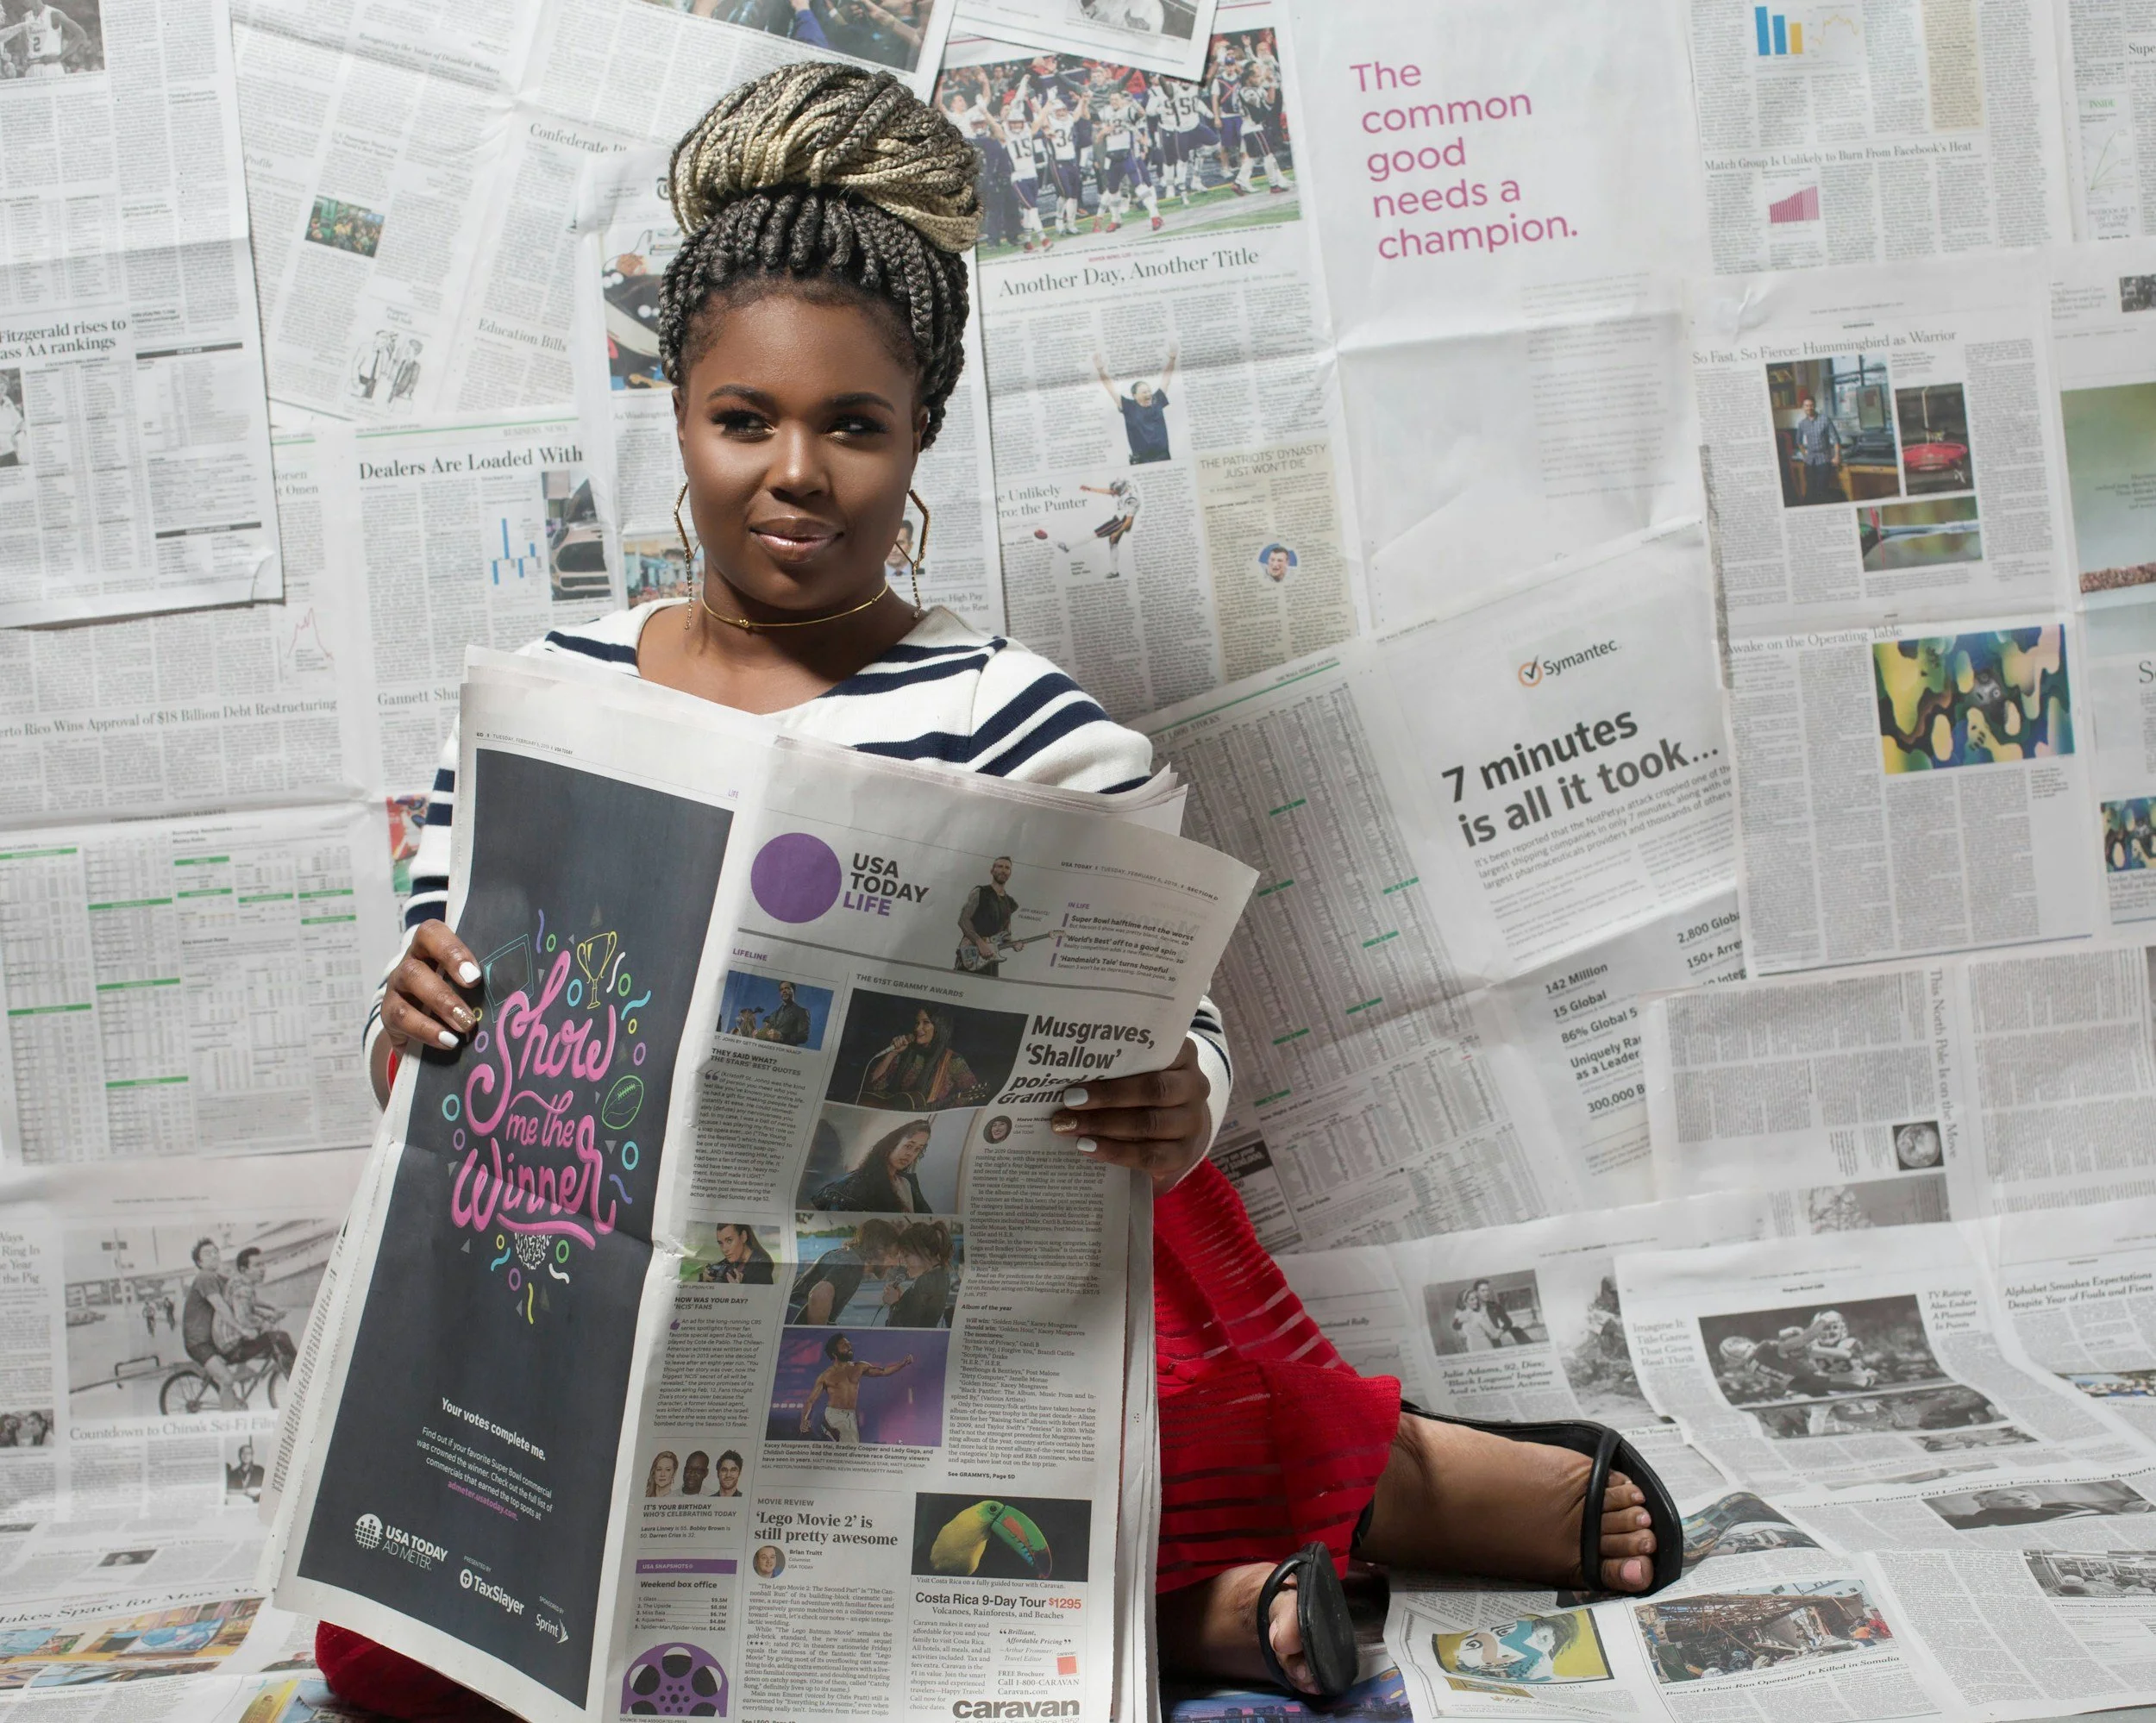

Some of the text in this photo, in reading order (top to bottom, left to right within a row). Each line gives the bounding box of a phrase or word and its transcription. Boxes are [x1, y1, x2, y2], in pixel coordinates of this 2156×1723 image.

[1349, 60, 1421, 91] The
[1362, 94, 1532, 134] common
[1367, 136, 1465, 182] good
[1704, 141, 1971, 171] Match Group Is Unlikely to Burn From Facebook's Heat
[1373, 179, 1520, 218] needs a
[1379, 216, 1576, 259] champion.
[1000, 247, 1258, 297] Another Day, Another Title
[73, 320, 108, 335] rises
[110, 319, 126, 331] to
[27, 343, 47, 356] AA
[50, 337, 116, 354] rankings
[1691, 329, 1956, 365] So Fast, So Fierce: Hummingbird as Warrior
[359, 444, 583, 479] Dealers Are Loaded With
[1766, 641, 1783, 650] on
[1785, 635, 1804, 648] the
[1807, 626, 1868, 648] Operating
[1866, 622, 1903, 639] Table
[1542, 640, 1617, 676] Symantec
[23, 722, 51, 736] Rico
[53, 719, 84, 732] Wins
[86, 713, 140, 732] Approval
[141, 711, 156, 725] of
[156, 710, 178, 725] $18
[180, 708, 220, 722] Billion
[222, 705, 252, 718] Debt
[254, 699, 337, 716] Restructuring
[1441, 711, 1637, 803] 7 minutes
[1457, 738, 1718, 847] is all it took...
[1473, 856, 1489, 868] It's
[1488, 849, 1511, 862] been
[1512, 832, 1550, 853] reported
[1550, 825, 1569, 839] that
[1569, 820, 1584, 832] the
[1626, 793, 1654, 810] attack
[1654, 779, 1690, 799] crippled
[1690, 774, 1708, 786] one
[1708, 768, 1718, 780] of
[852, 853, 899, 879] USA
[851, 873, 929, 903] TODAY
[843, 891, 892, 917] LIFE
[1070, 914, 1093, 924] Super
[1092, 916, 1111, 924] Bowl
[1110, 918, 1142, 929] halftime
[1156, 926, 1171, 935] the
[1171, 930, 1194, 942] worst
[732, 948, 768, 962] LIFELINE
[1059, 955, 1169, 974] 'Handmaid's Tale' turns hopeful
[856, 973, 964, 998] THE 61ST GRAMMY AWARDS
[1545, 963, 1608, 994] 142 Million
[1552, 989, 1607, 1018] 15 Global
[1031, 1014, 1154, 1049] Musgraves,
[1560, 1027, 1589, 1043] 86%
[1589, 1010, 1627, 1032] Global
[464, 950, 617, 1137] Show
[1026, 1043, 1122, 1069] 'Shallow'
[1929, 968, 1958, 1158] This North Pole Is on the Move
[1587, 1087, 1634, 1112] 300,000
[506, 1107, 538, 1146] me
[451, 1114, 616, 1236] Winner
[69, 1425, 143, 1440] Countdown
[146, 1425, 160, 1437] to
[161, 1420, 207, 1435] China's
[209, 1417, 248, 1432] Sci-Fi
[442, 1398, 546, 1461] Your votes complete me.
[783, 1498, 814, 1507] REVIEW
[755, 1510, 873, 1529] 'Lego Movie 2' is
[381, 1541, 399, 1556] AD
[385, 1526, 448, 1562] USA TODAY
[754, 1527, 898, 1545] still pretty awesome
[473, 1576, 525, 1615] TaxSlayer
[915, 1592, 1081, 1609] Costa Rica 9-Day Tour $1295
[536, 1613, 559, 1638] Sprint
[1702, 1682, 1755, 1692] Dubai-Run
[1757, 1673, 1805, 1685] Operation
[1818, 1663, 1846, 1673] Killed
[1859, 1656, 1900, 1666] Somalia
[952, 1700, 1080, 1719] caravan
